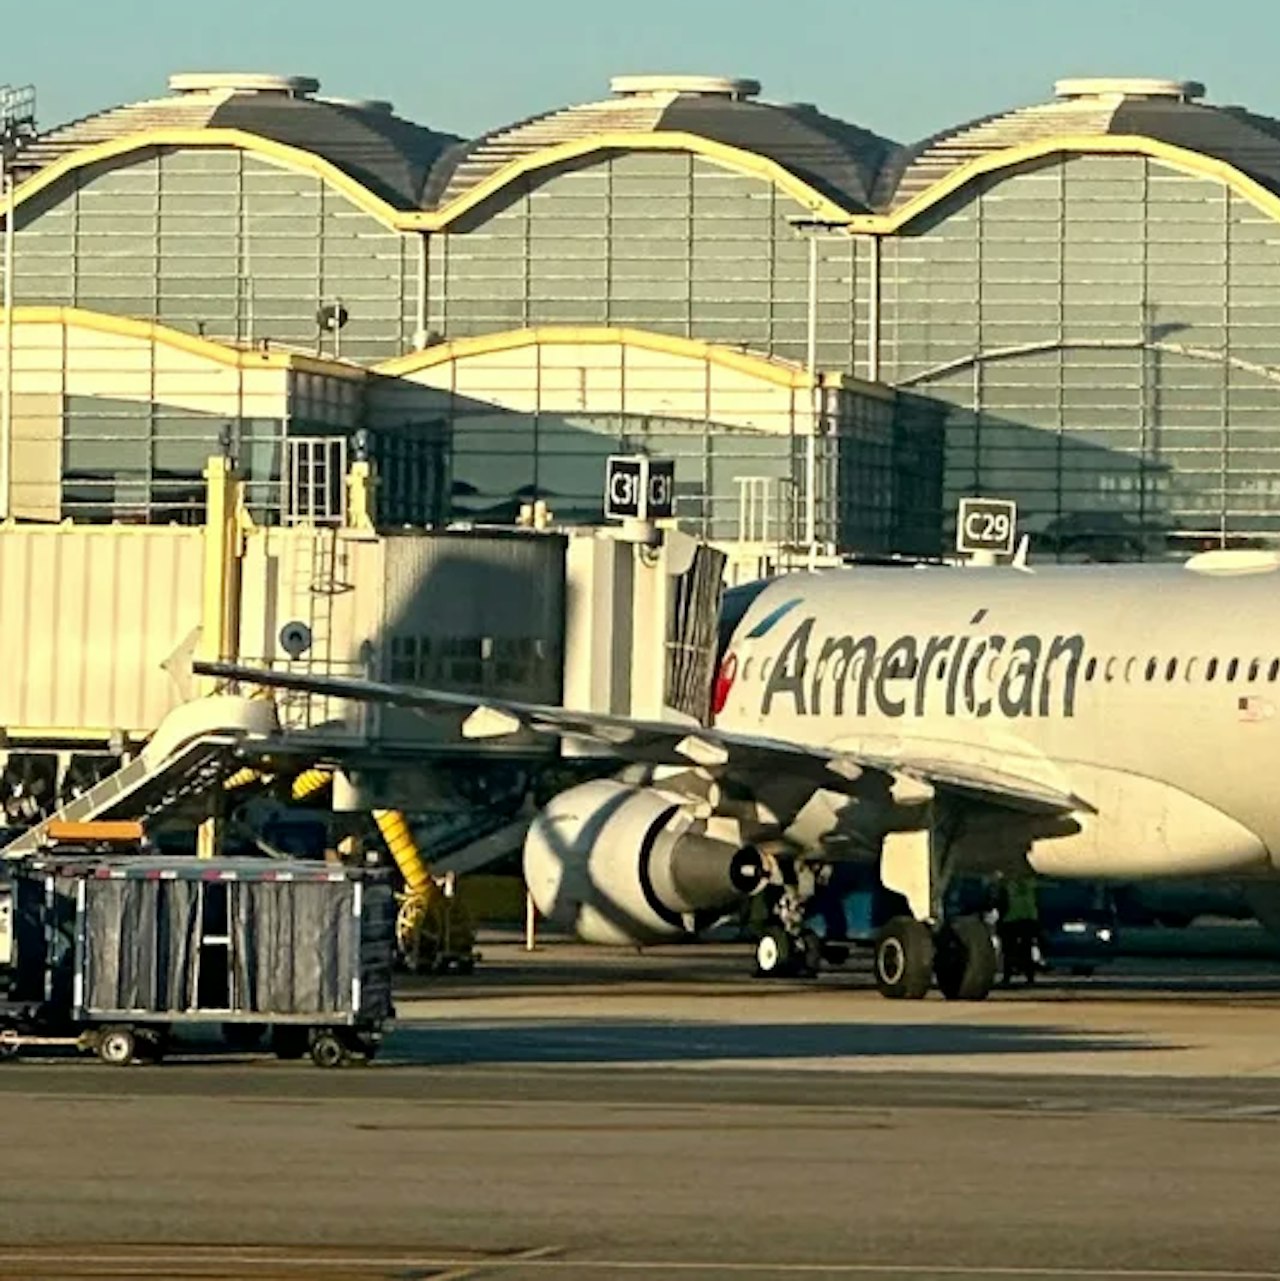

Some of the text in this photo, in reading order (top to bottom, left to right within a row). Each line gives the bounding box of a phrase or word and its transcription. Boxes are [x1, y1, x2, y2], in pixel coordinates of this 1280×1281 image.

[610, 471, 638, 505] C31
[965, 512, 1009, 540] C29
[761, 609, 1085, 717] American
